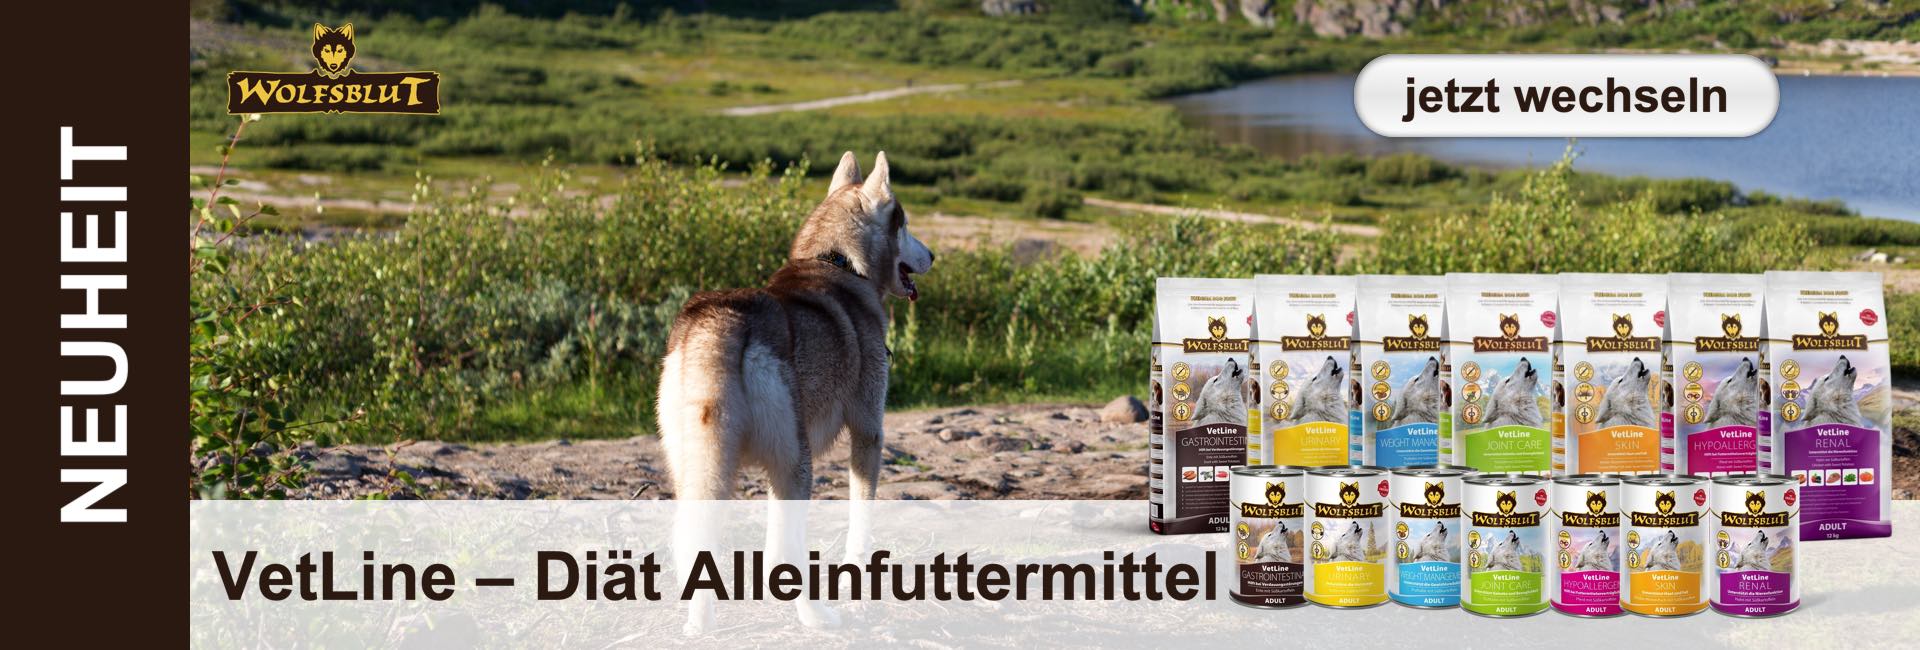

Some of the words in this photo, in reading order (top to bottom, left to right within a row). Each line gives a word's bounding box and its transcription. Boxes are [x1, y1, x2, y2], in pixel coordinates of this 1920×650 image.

[1207, 427, 1237, 435] VetLine
[1498, 430, 1530, 438] VetLine
[1611, 430, 1644, 438] VetLine
[1720, 430, 1752, 438] VetLine
[1817, 428, 1849, 436] VetLine
[1487, 441, 1514, 450] JOINT
[1517, 440, 1543, 449] CARE
[1815, 438, 1851, 448] RENAL
[1819, 522, 1847, 531] ADULT
[1655, 581, 1676, 591] SKIN
[1738, 581, 1772, 591] RENAL
